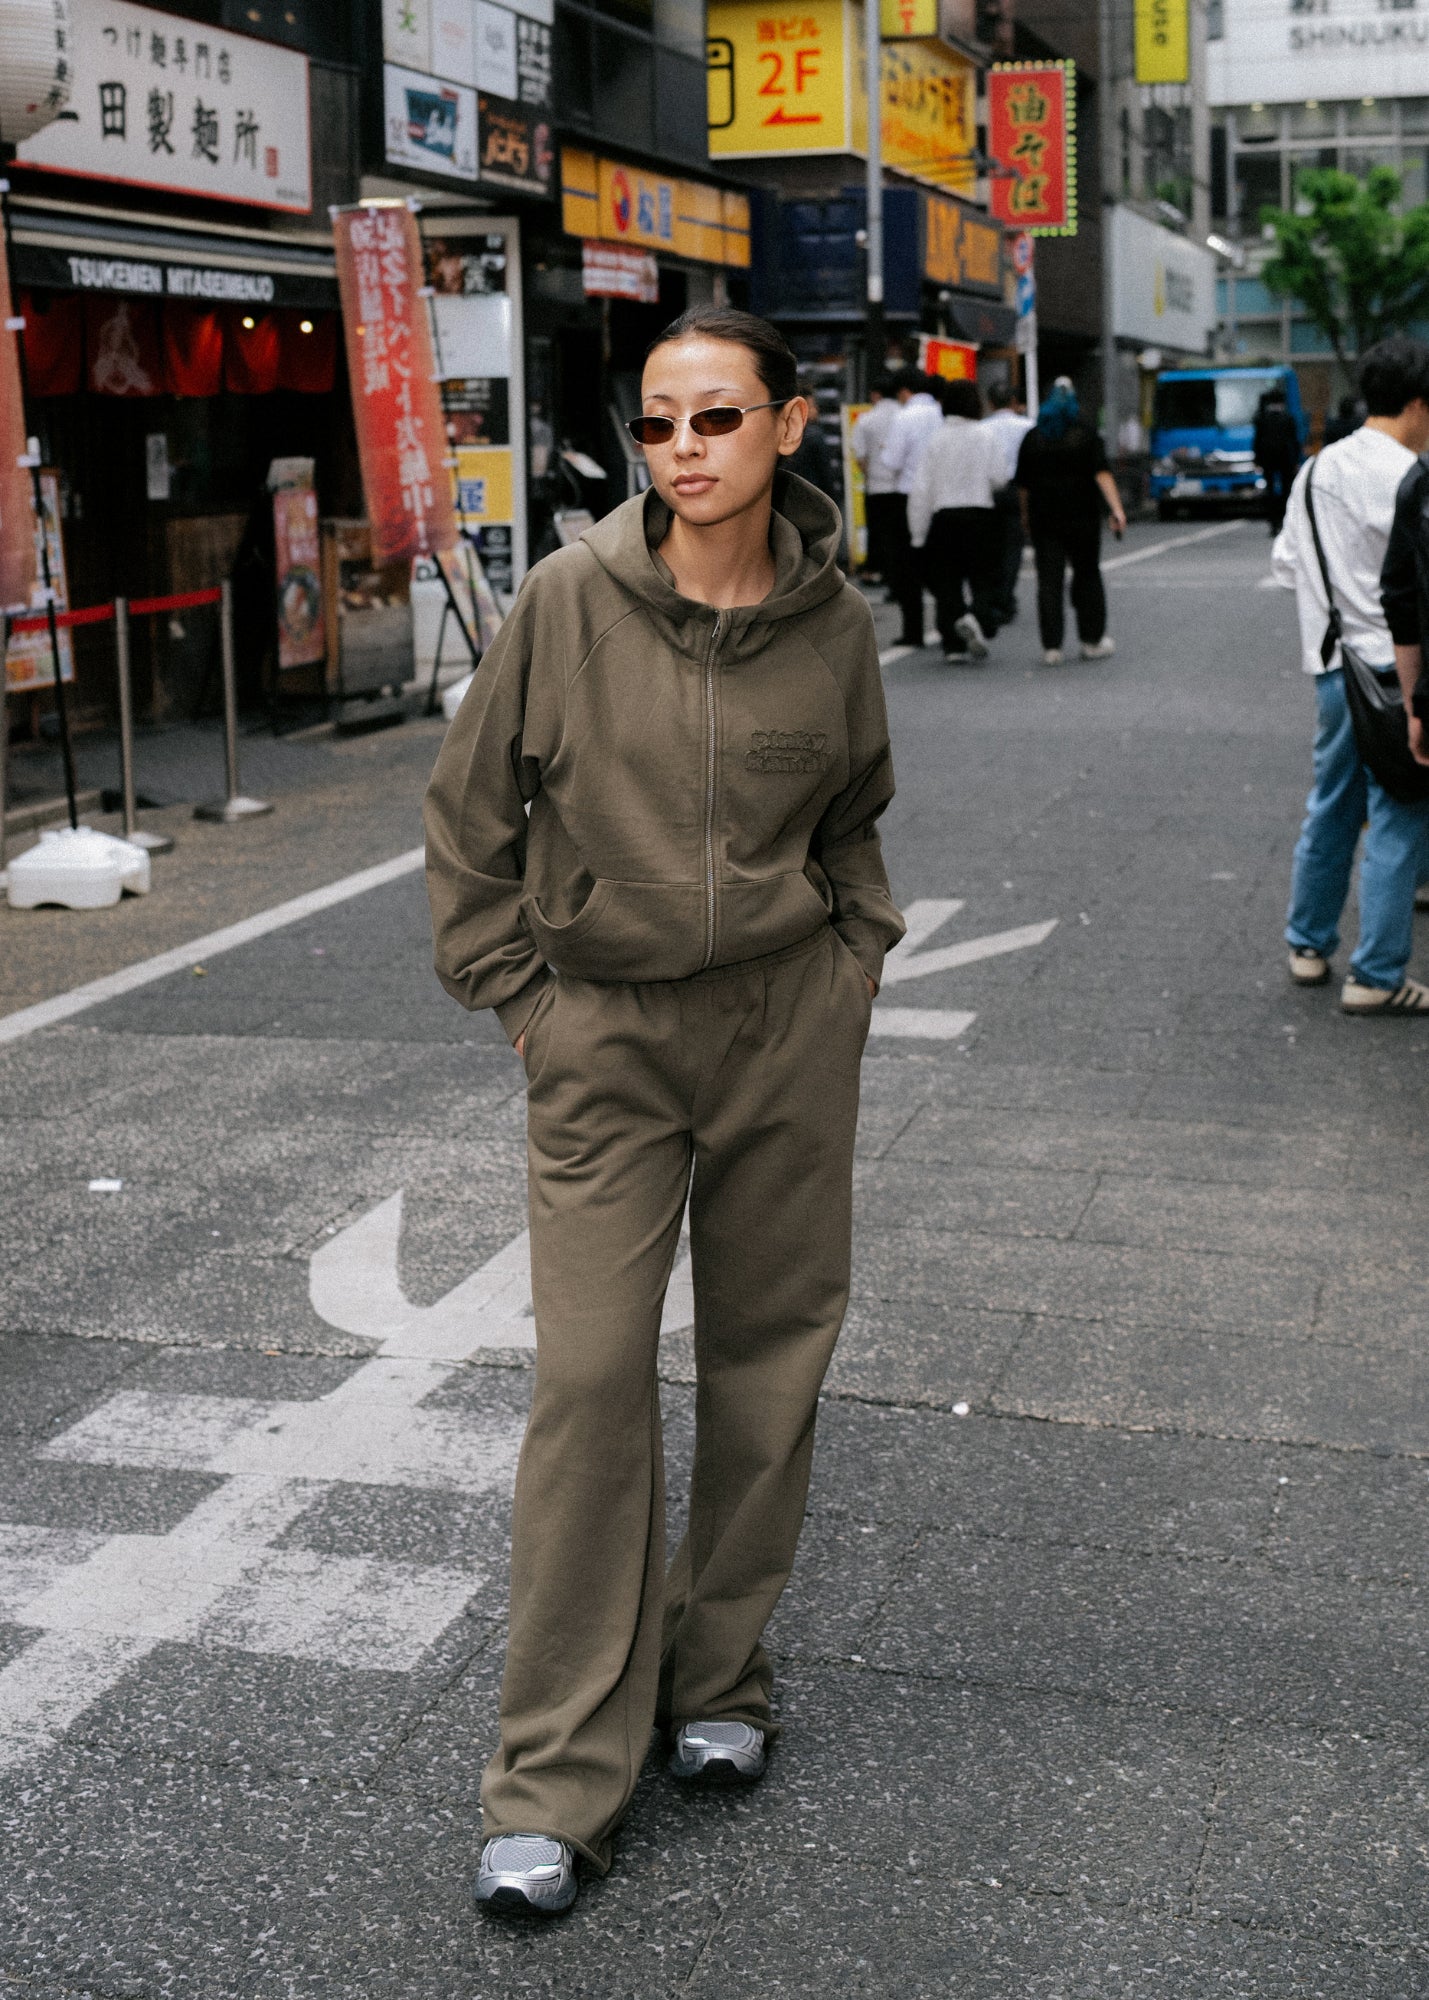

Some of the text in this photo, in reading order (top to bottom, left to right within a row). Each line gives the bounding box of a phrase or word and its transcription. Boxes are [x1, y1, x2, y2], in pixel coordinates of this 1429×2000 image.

[102, 25, 232, 85] つけ麺専門店
[758, 48, 822, 95] 2F
[57, 80, 259, 171] 田製麺所
[1008, 84, 1050, 215] 油そば
[67, 256, 163, 293] TSUKEMEN
